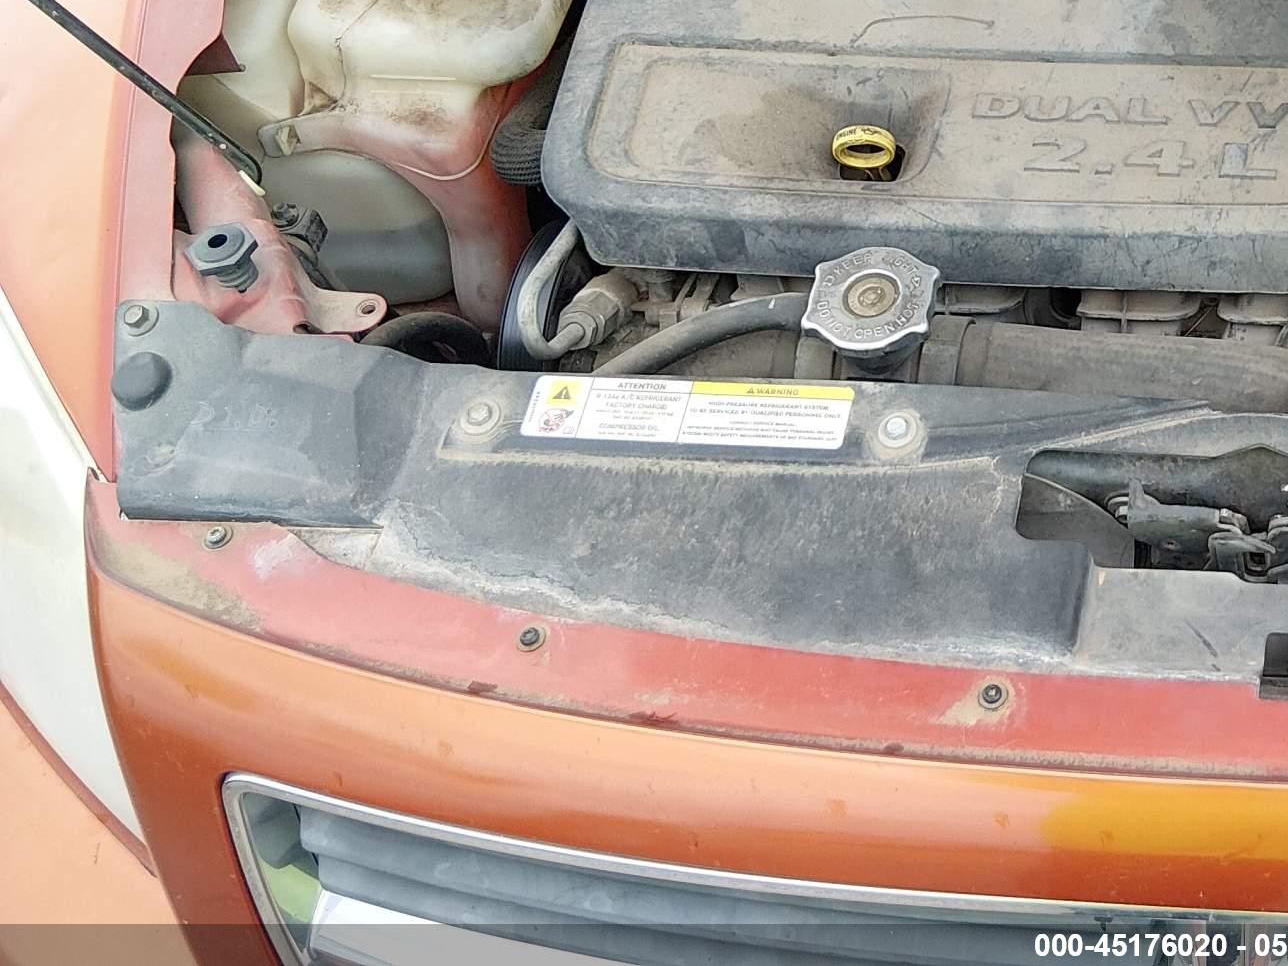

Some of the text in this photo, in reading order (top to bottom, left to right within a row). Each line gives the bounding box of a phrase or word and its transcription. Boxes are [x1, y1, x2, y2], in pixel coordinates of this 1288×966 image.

[971, 92, 1168, 125] DUAL
[855, 325, 896, 339] OPEN
[896, 302, 919, 327] HOT
[617, 382, 666, 390] ATTENTION
[757, 387, 799, 395] WARNING
